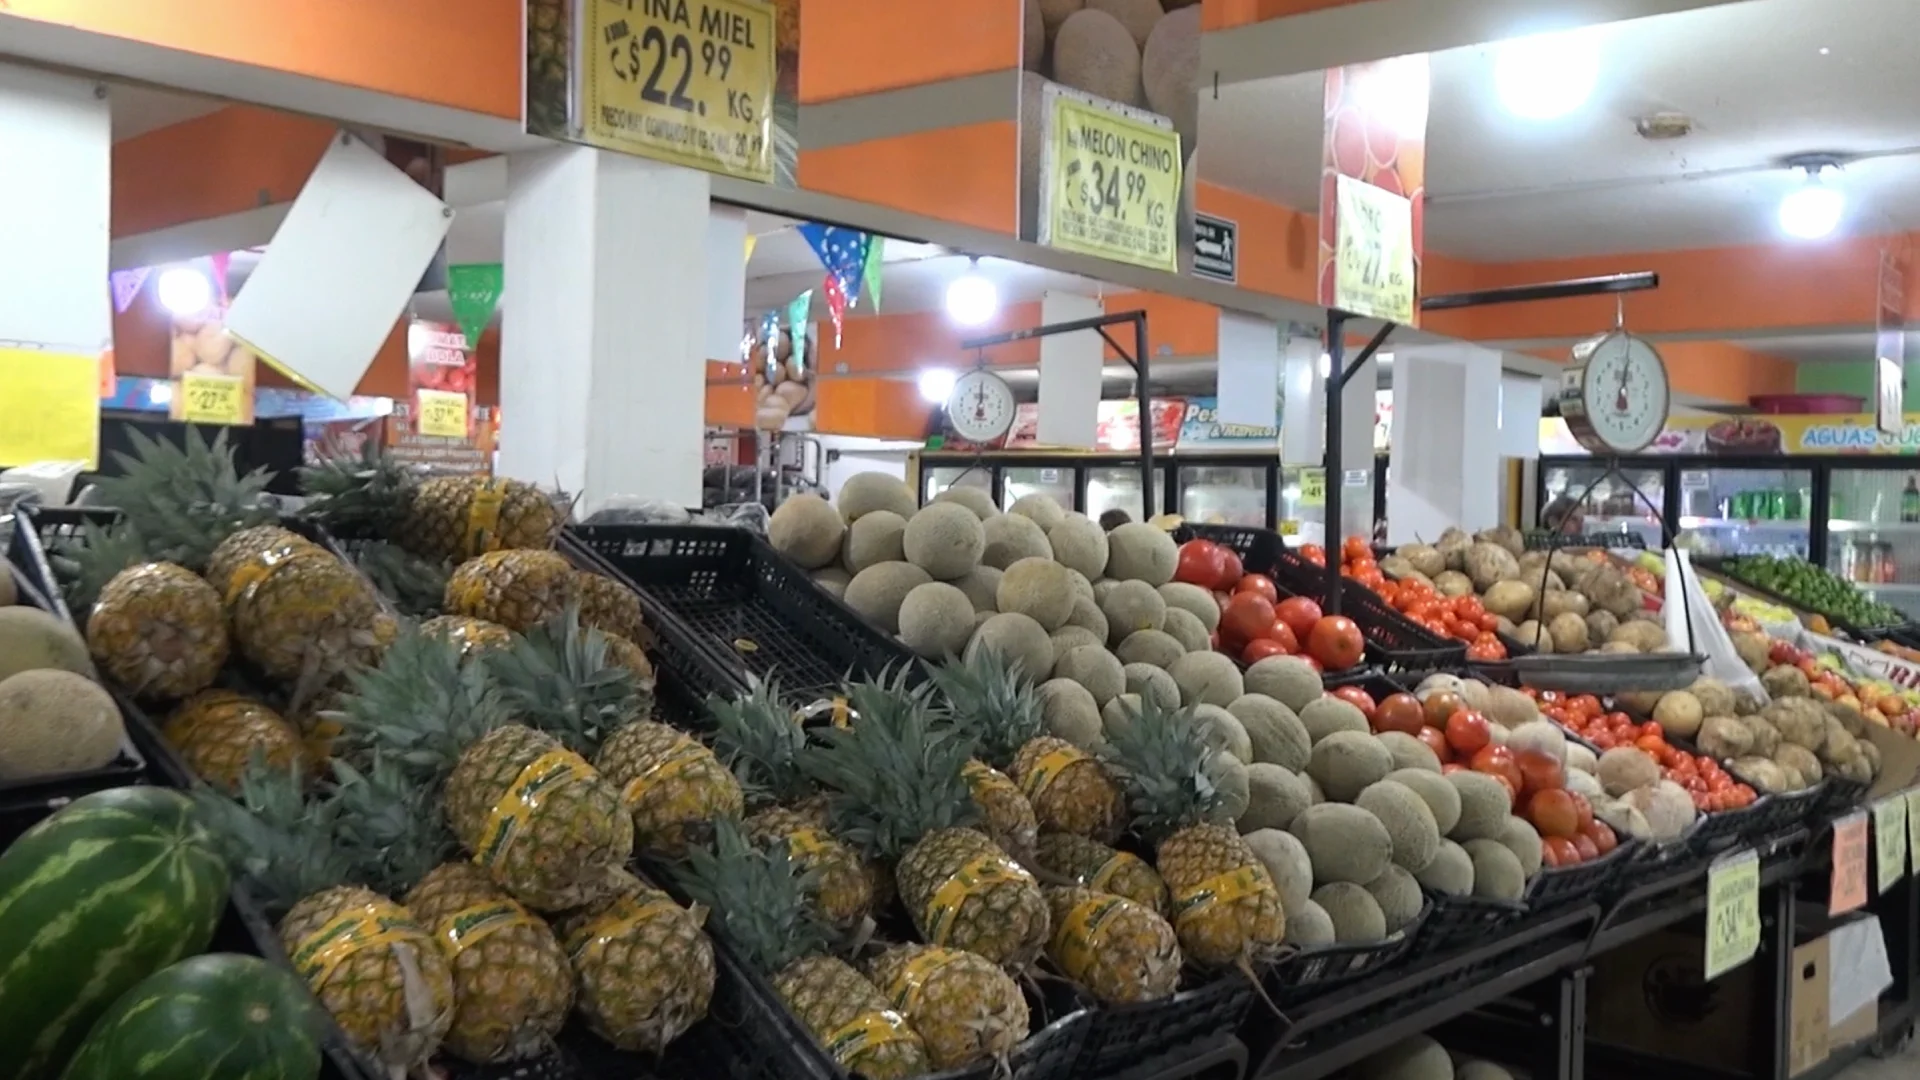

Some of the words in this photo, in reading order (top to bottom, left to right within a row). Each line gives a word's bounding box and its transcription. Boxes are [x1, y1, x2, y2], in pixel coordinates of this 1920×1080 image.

[699, 5, 755, 49] MIEL
[1080, 126, 1126, 160] MELON
[1130, 140, 1172, 174] CHINO
[427, 348, 465, 365] BOLA
[1803, 427, 1877, 446] AGUAS
